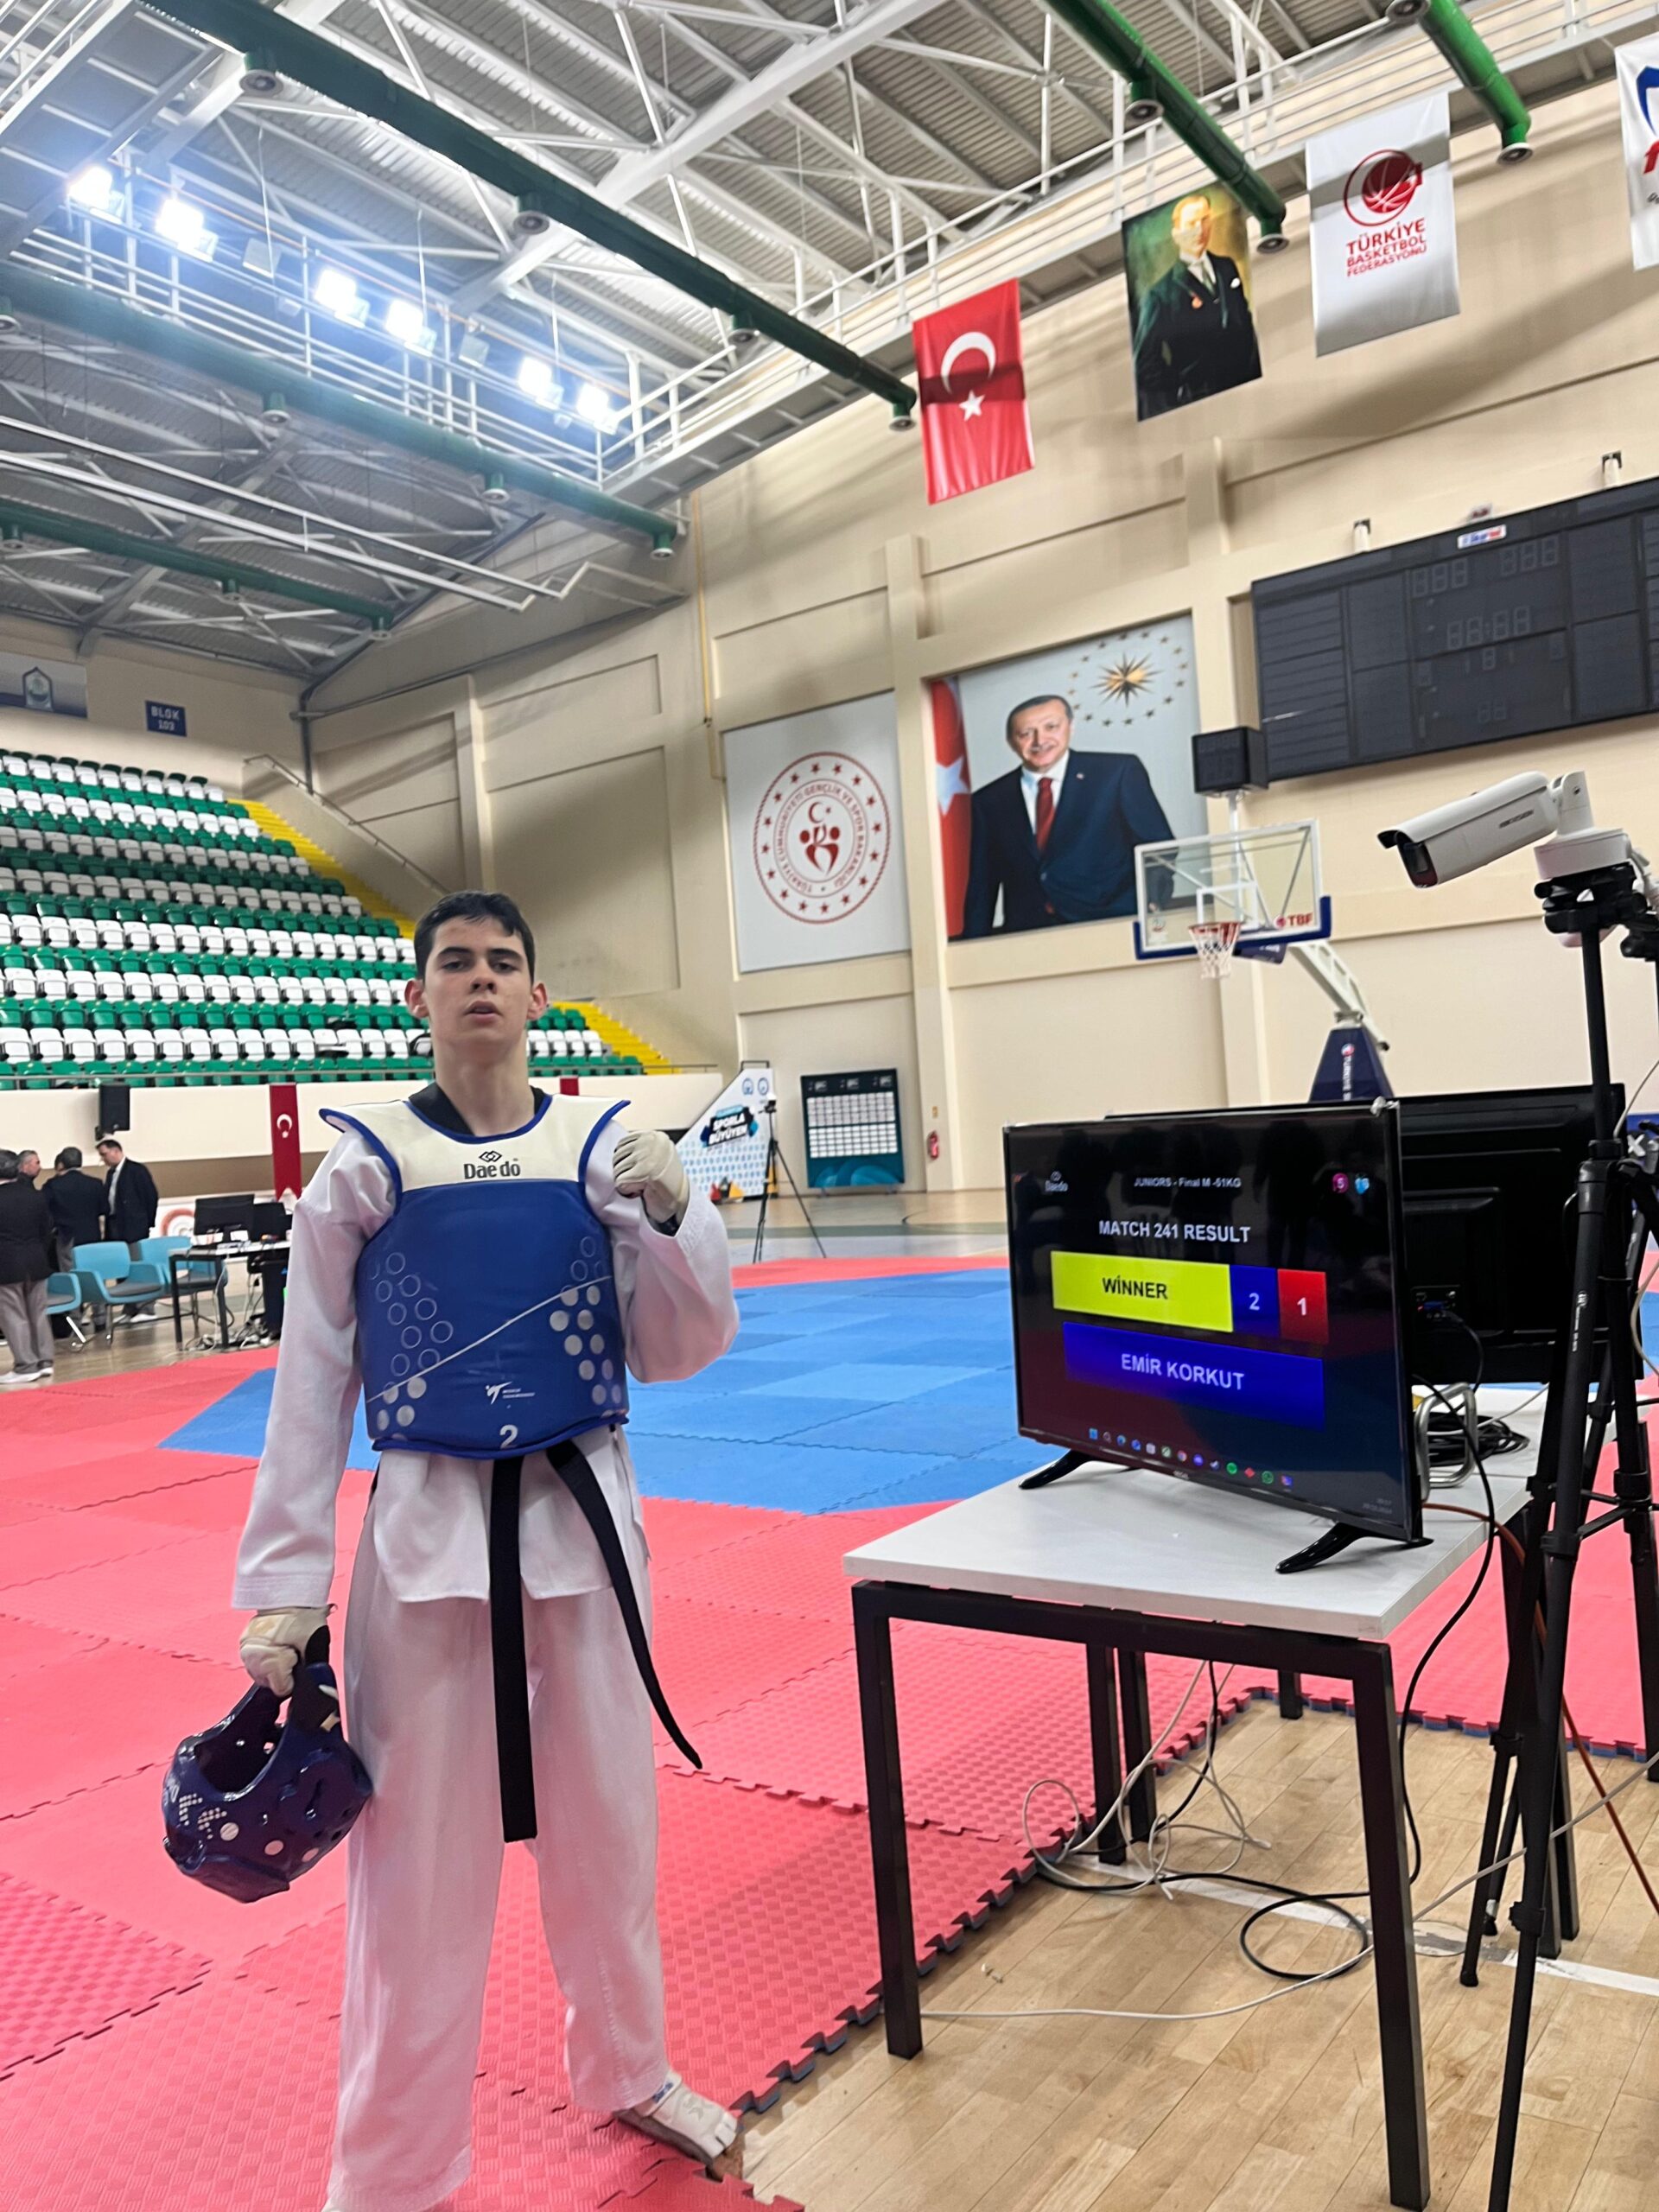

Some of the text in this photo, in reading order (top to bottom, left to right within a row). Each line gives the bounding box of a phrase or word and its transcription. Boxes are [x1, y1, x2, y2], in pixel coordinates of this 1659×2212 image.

[1346, 217, 1426, 255] TÜRKİYE
[1347, 234, 1426, 267] BASKETBOL
[1347, 245, 1427, 277] FEDERASYONU
[151, 705, 180, 721] BLOK
[1287, 912, 1313, 926] TBF
[1134, 1176, 1172, 1188] JUNIORS
[1098, 1219, 1251, 1243] MATCH 241 RESULT
[1102, 1274, 1168, 1300] WİNNER
[1249, 1292, 1261, 1312] 2
[1296, 1296, 1308, 1316] 1
[1121, 1353, 1245, 1391] EMİR KORKUT
[499, 1423, 518, 1449] 2
